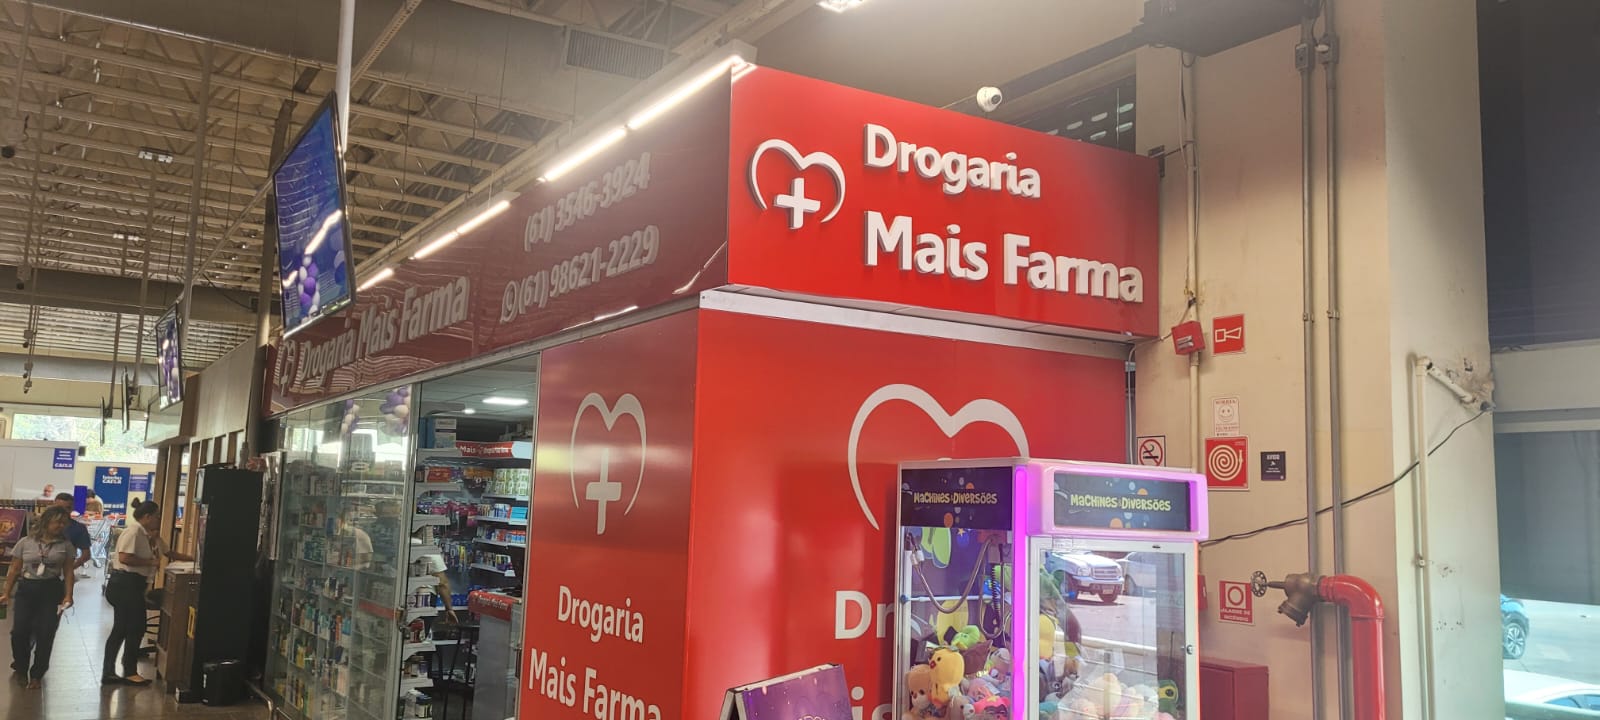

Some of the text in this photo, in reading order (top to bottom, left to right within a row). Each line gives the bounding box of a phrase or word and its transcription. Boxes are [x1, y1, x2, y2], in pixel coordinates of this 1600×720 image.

[524, 152, 651, 252] (61) 3546-3924
[863, 123, 1041, 199] Drogaria
[519, 225, 660, 314] (61) 98621-2229
[864, 210, 1144, 304] Mais Farma
[300, 275, 470, 387] Drogaria Mais Farma
[558, 585, 644, 644] Drogaria
[528, 647, 577, 707] Mais
